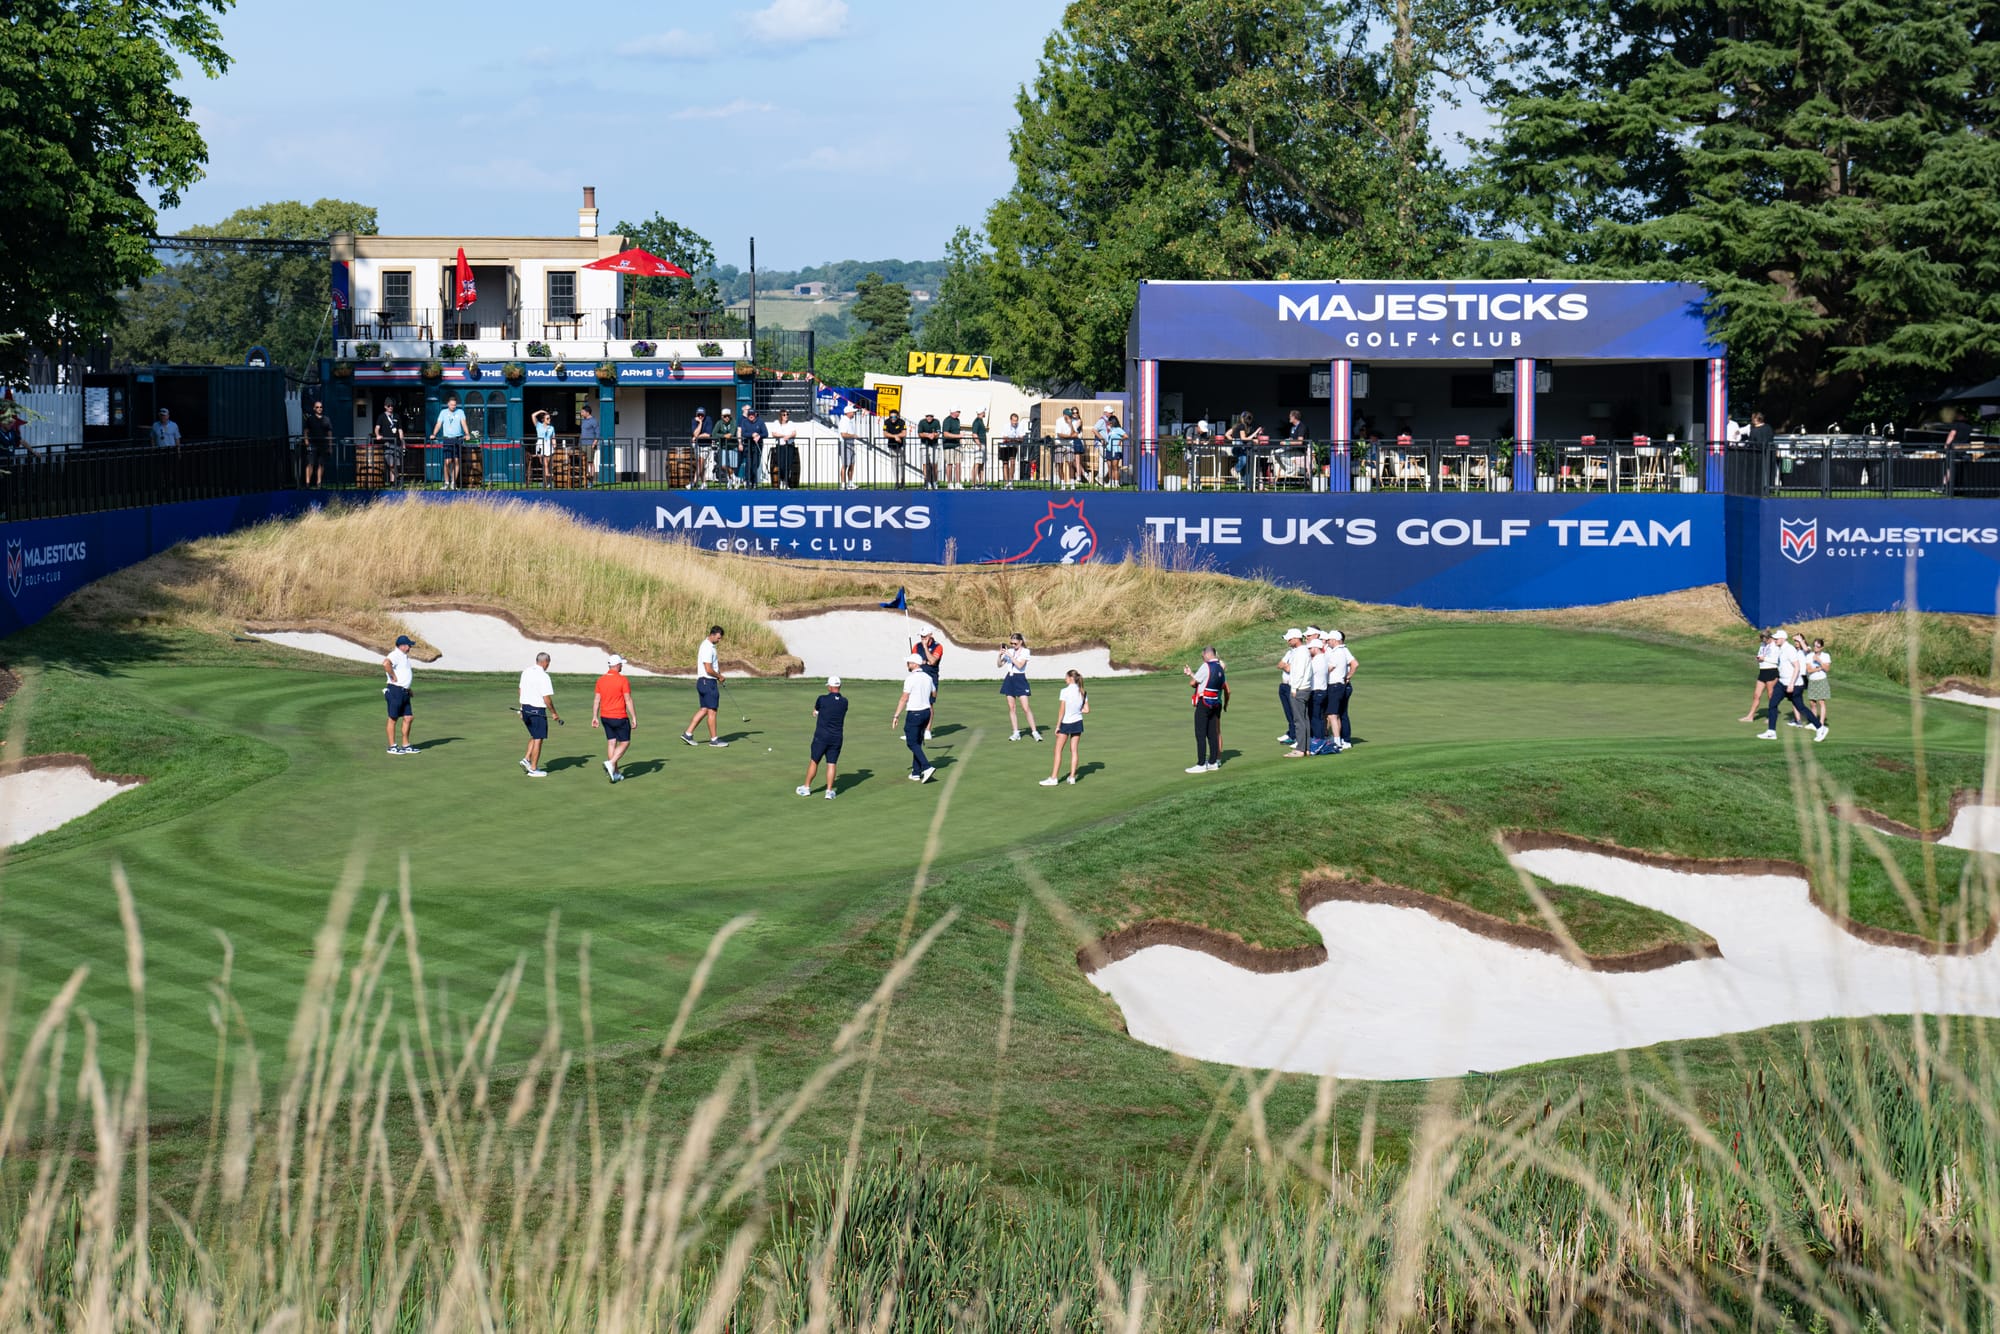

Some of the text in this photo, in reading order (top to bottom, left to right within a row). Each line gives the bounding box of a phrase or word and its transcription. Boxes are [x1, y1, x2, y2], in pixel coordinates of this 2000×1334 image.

[1278, 293, 1589, 322] MAJESTICKS
[1345, 331, 1523, 348] GOLF CLUB
[480, 369, 653, 378] THE MAJESTICKS ARMS
[907, 351, 990, 379] PIZZA
[655, 505, 931, 529] MAJESTICKS
[1144, 516, 1692, 548] THE UK'S GOLF TEAM
[1826, 527, 1998, 544] MAJESTICKS
[716, 538, 872, 551] GOLF CLUB
[1826, 548, 1925, 558] GOLF CLUB
[24, 541, 86, 567] MAJESTICKS
[25, 570, 61, 586] GOLF CLUB
